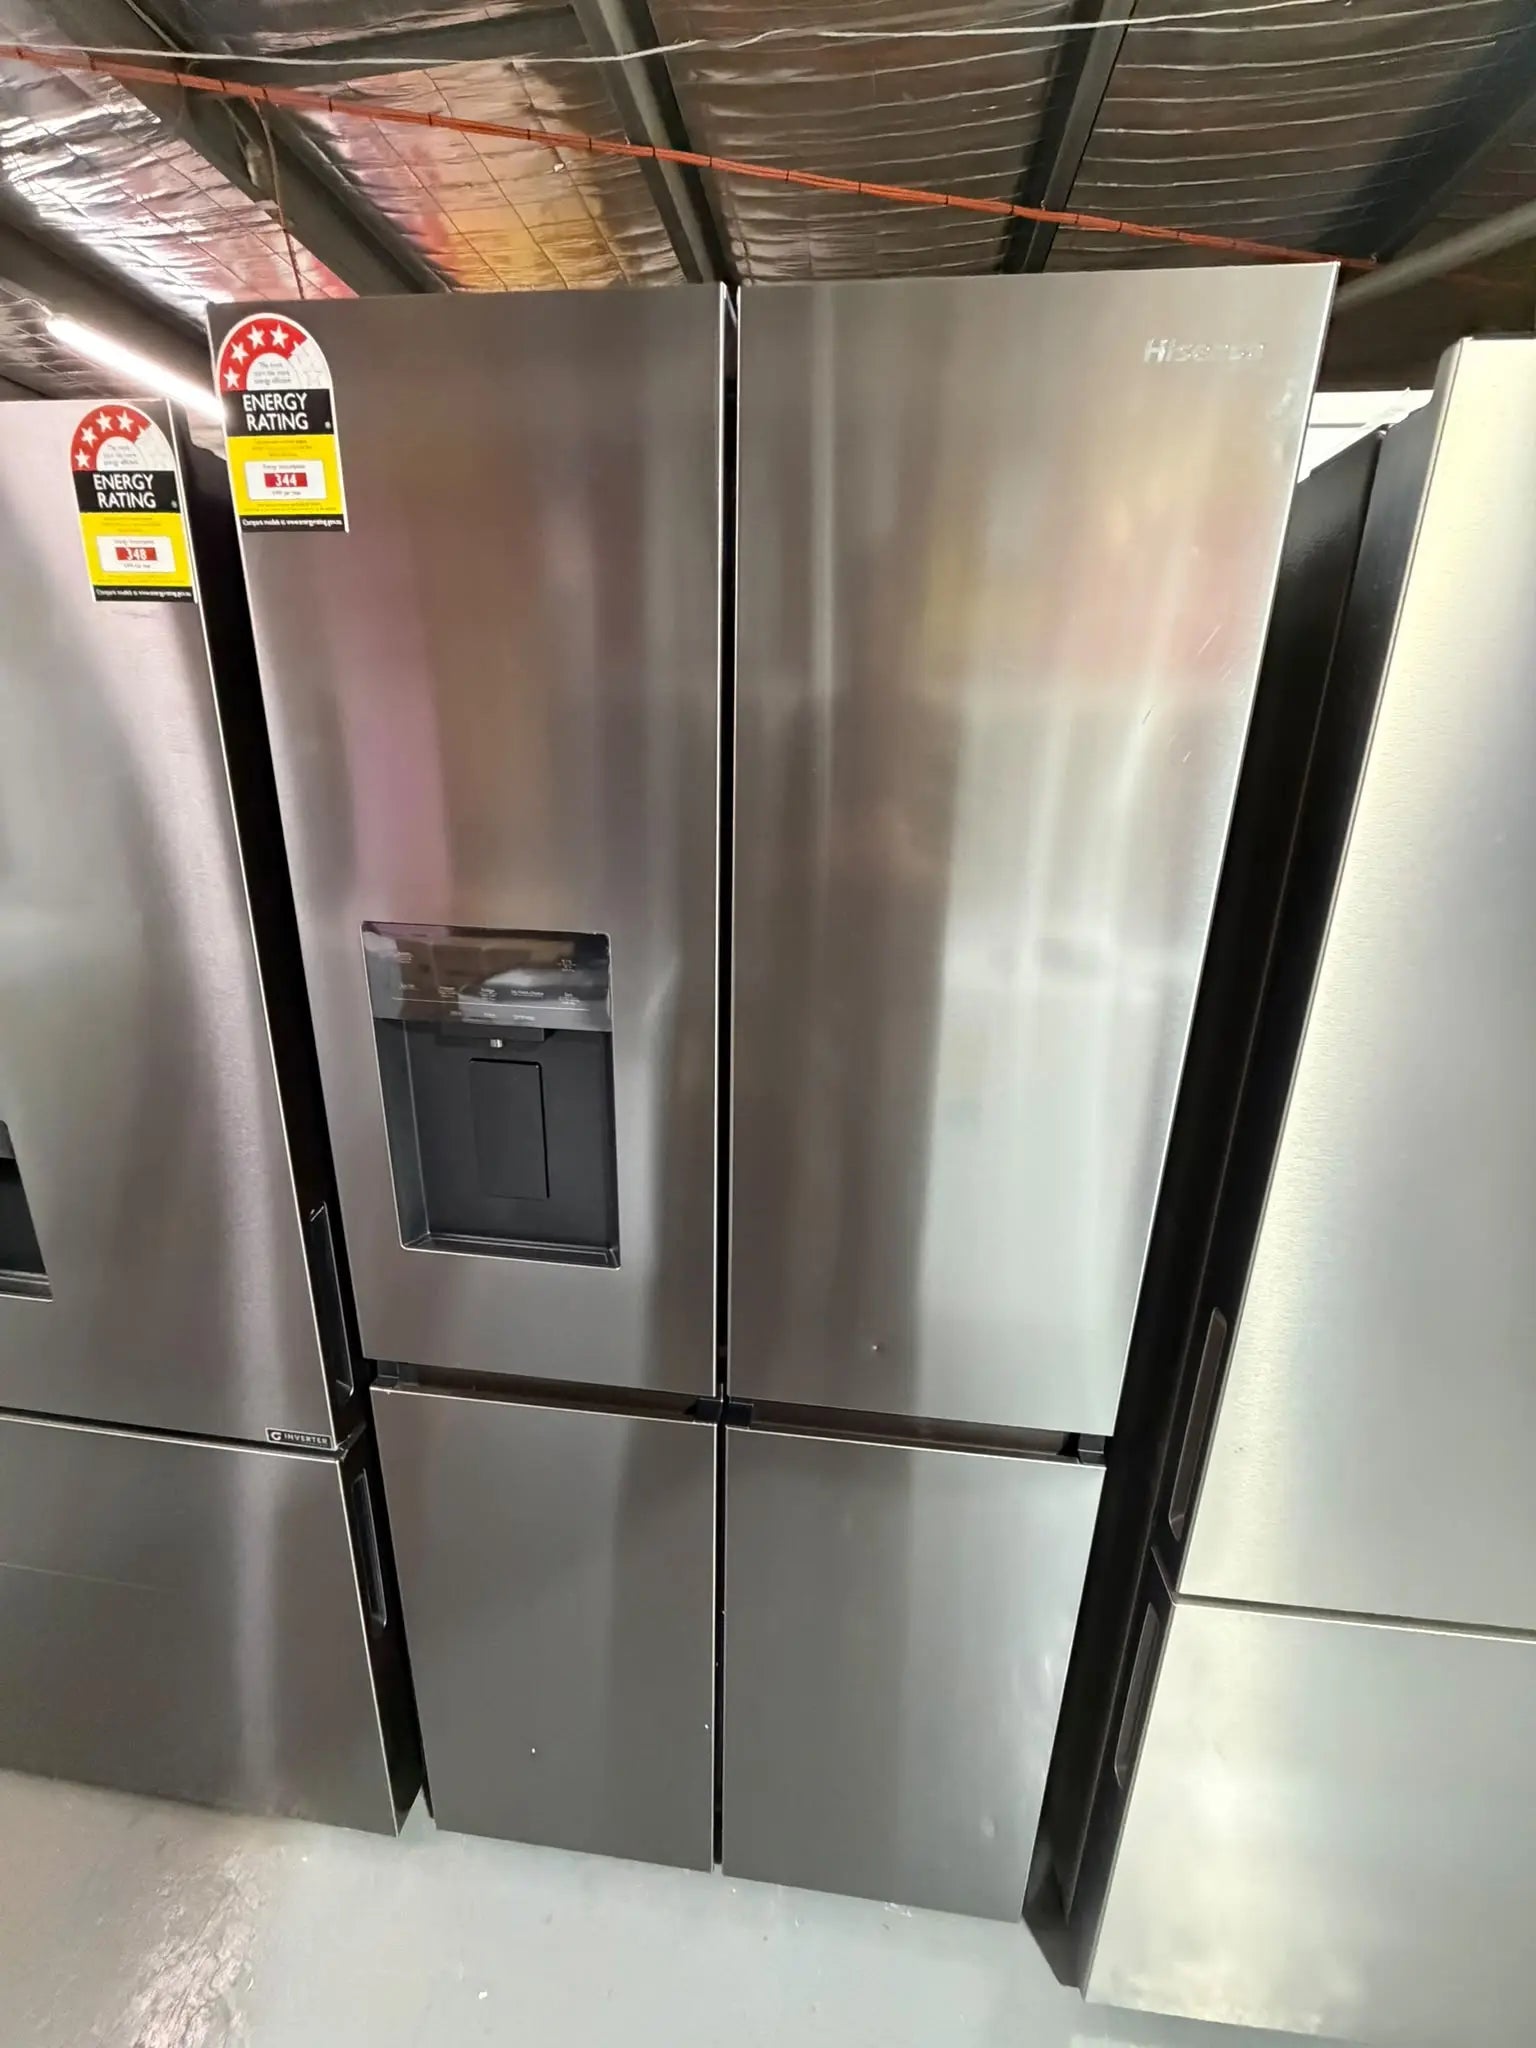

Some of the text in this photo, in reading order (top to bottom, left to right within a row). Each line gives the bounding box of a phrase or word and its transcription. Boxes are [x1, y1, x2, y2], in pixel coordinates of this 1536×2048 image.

[1143, 337, 1265, 362] Hise
[242, 392, 308, 412] ENERGY
[246, 412, 309, 431] RATING
[92, 473, 154, 490] ENERGY
[274, 473, 298, 487] 344
[97, 492, 157, 509] RATING
[126, 547, 148, 560] 348
[283, 1432, 328, 1444] INVERTER
